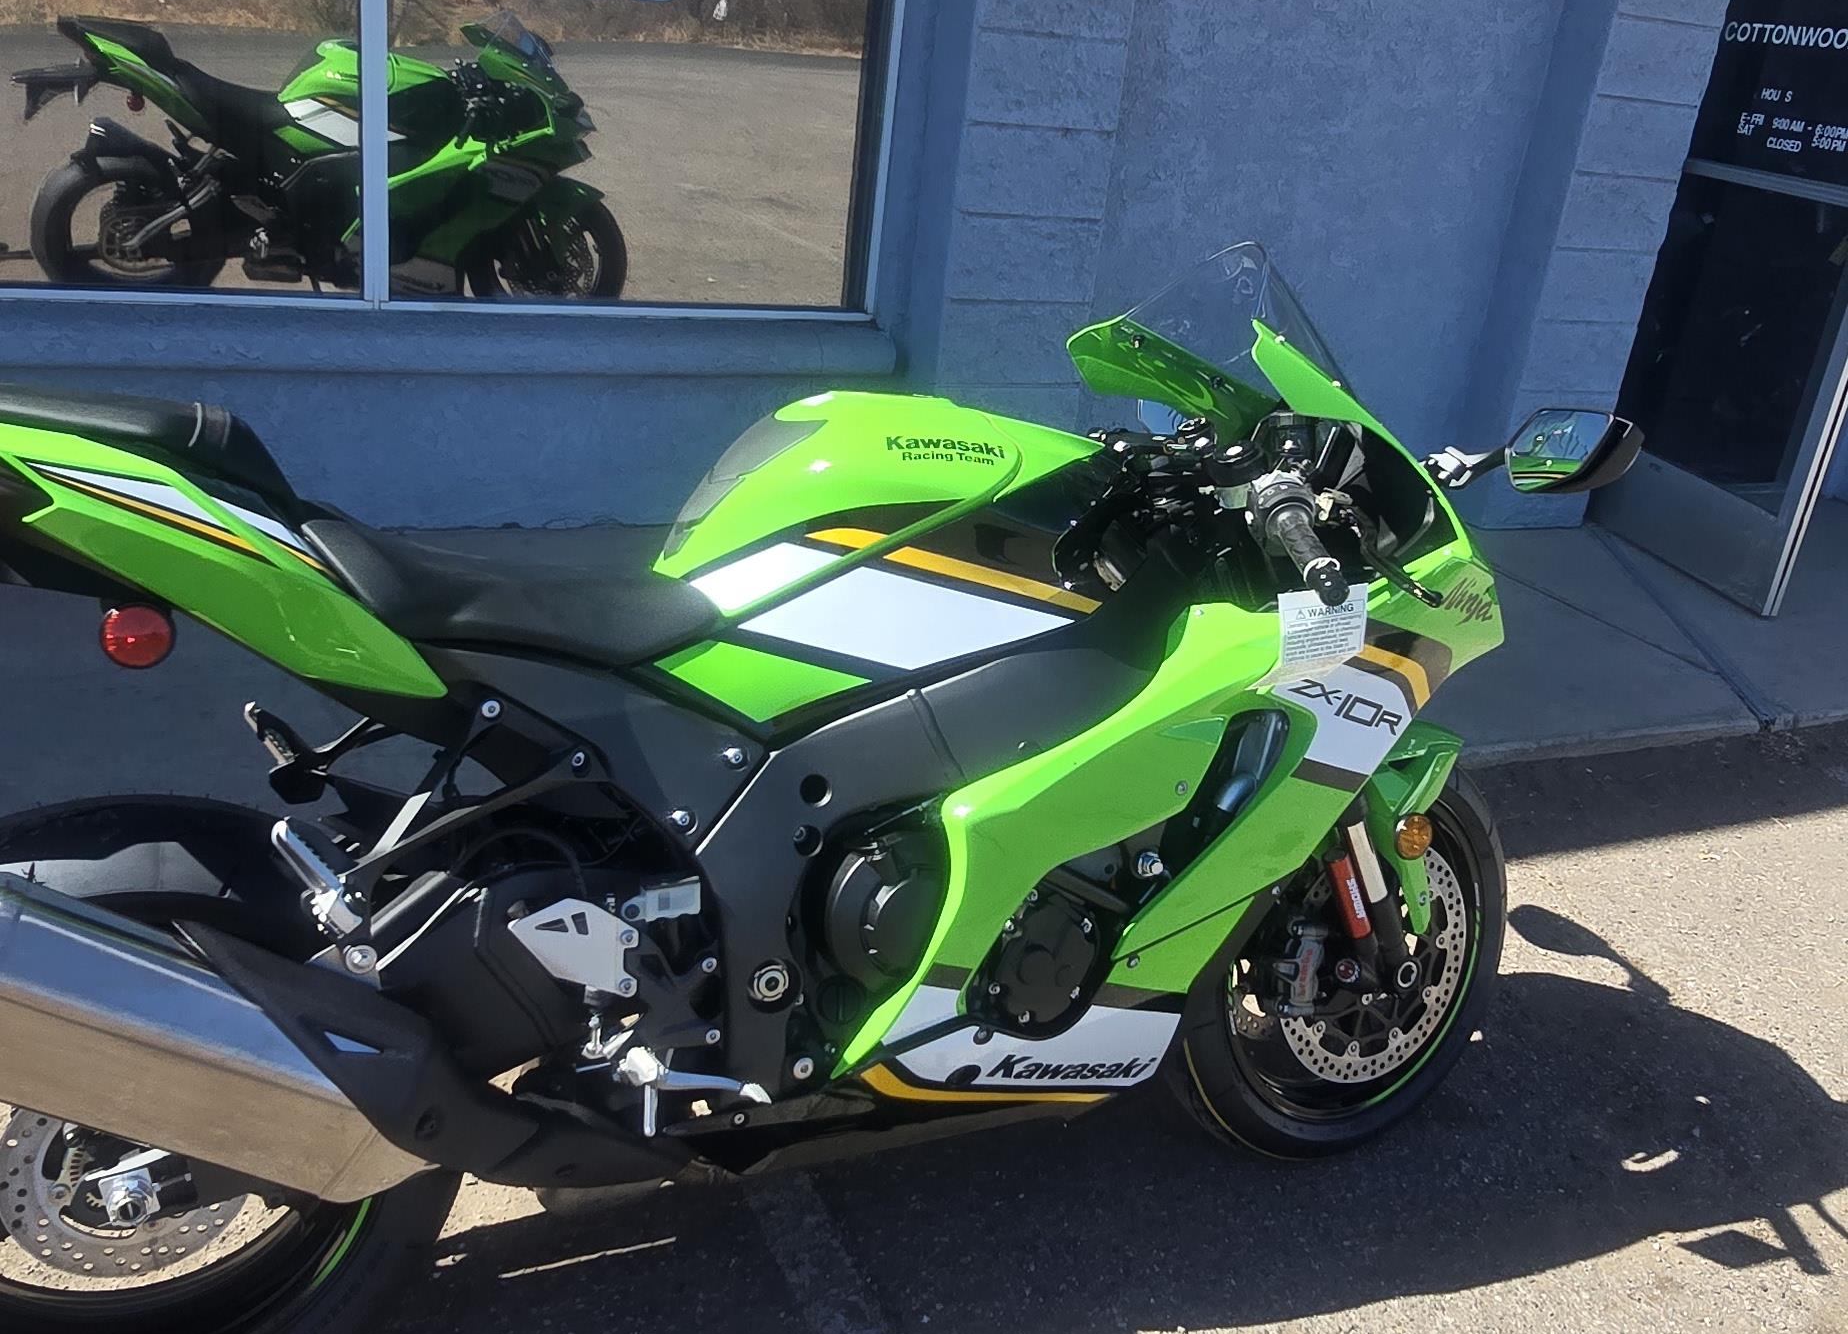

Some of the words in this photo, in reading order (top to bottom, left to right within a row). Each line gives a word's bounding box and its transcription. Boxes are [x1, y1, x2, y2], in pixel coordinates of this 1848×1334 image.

[1724, 21, 1848, 50] COTTONWOO
[1736, 122, 1755, 136] SAT
[1766, 136, 1802, 153] CLOSED
[886, 435, 1005, 459] Kawasaki
[902, 450, 954, 462] Racing
[956, 451, 995, 466] Team
[1307, 603, 1355, 618] WARNING
[1441, 576, 1493, 627] Ninja
[1287, 678, 1403, 737] ZX-10R
[985, 1053, 1158, 1081] Kawasaki
